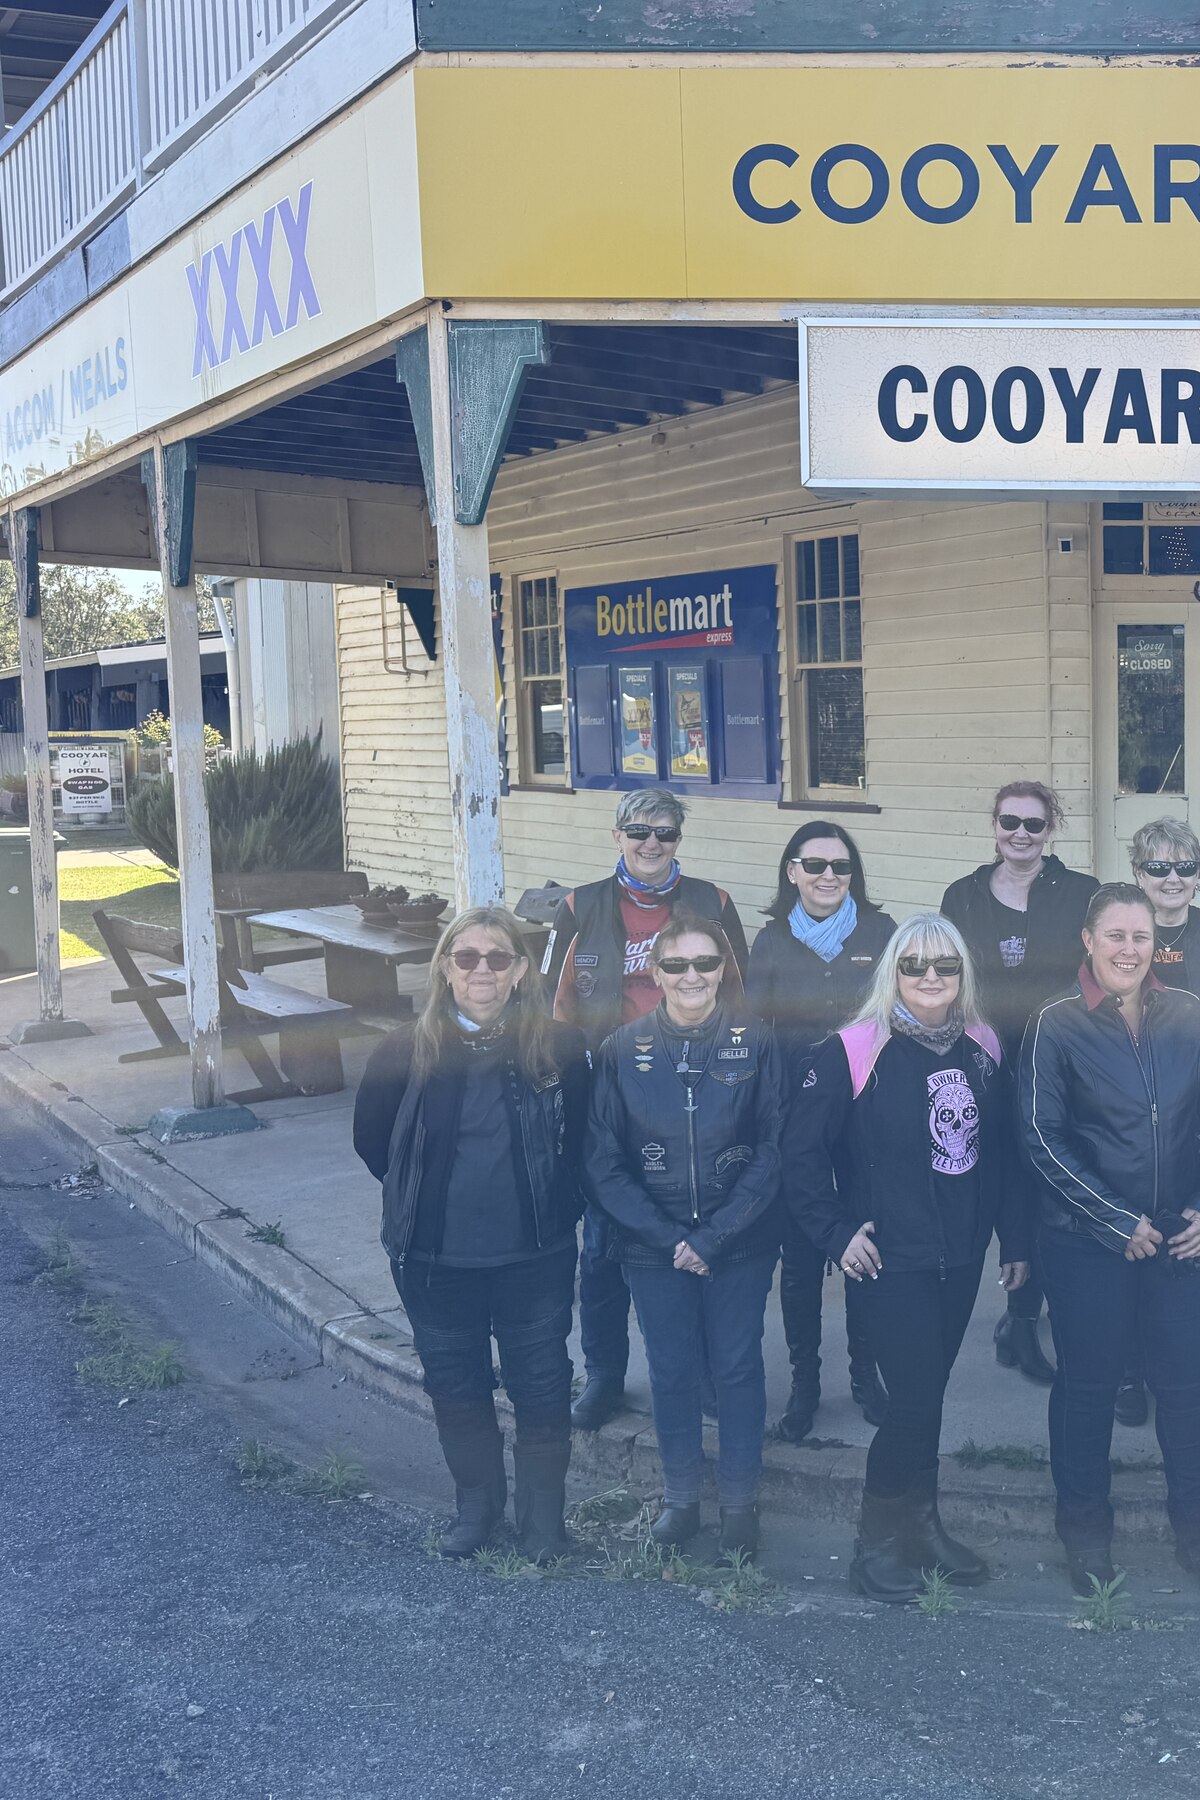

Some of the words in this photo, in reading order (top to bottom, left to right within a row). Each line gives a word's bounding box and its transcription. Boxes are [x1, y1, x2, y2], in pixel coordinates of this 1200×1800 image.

[184, 179, 322, 380] XXXX
[6, 384, 55, 456] ACCOM
[70, 336, 128, 419] MEALS
[597, 584, 734, 637] Bottlemart
[706, 632, 732, 645] express
[1135, 639, 1165, 654] Sorry
[1130, 658, 1171, 671] CLOSED
[626, 674, 647, 683] SPECIALS
[676, 672, 698, 681] SPECIALS
[727, 713, 760, 725] Bottlemart
[720, 1050, 746, 1058] BELLE
